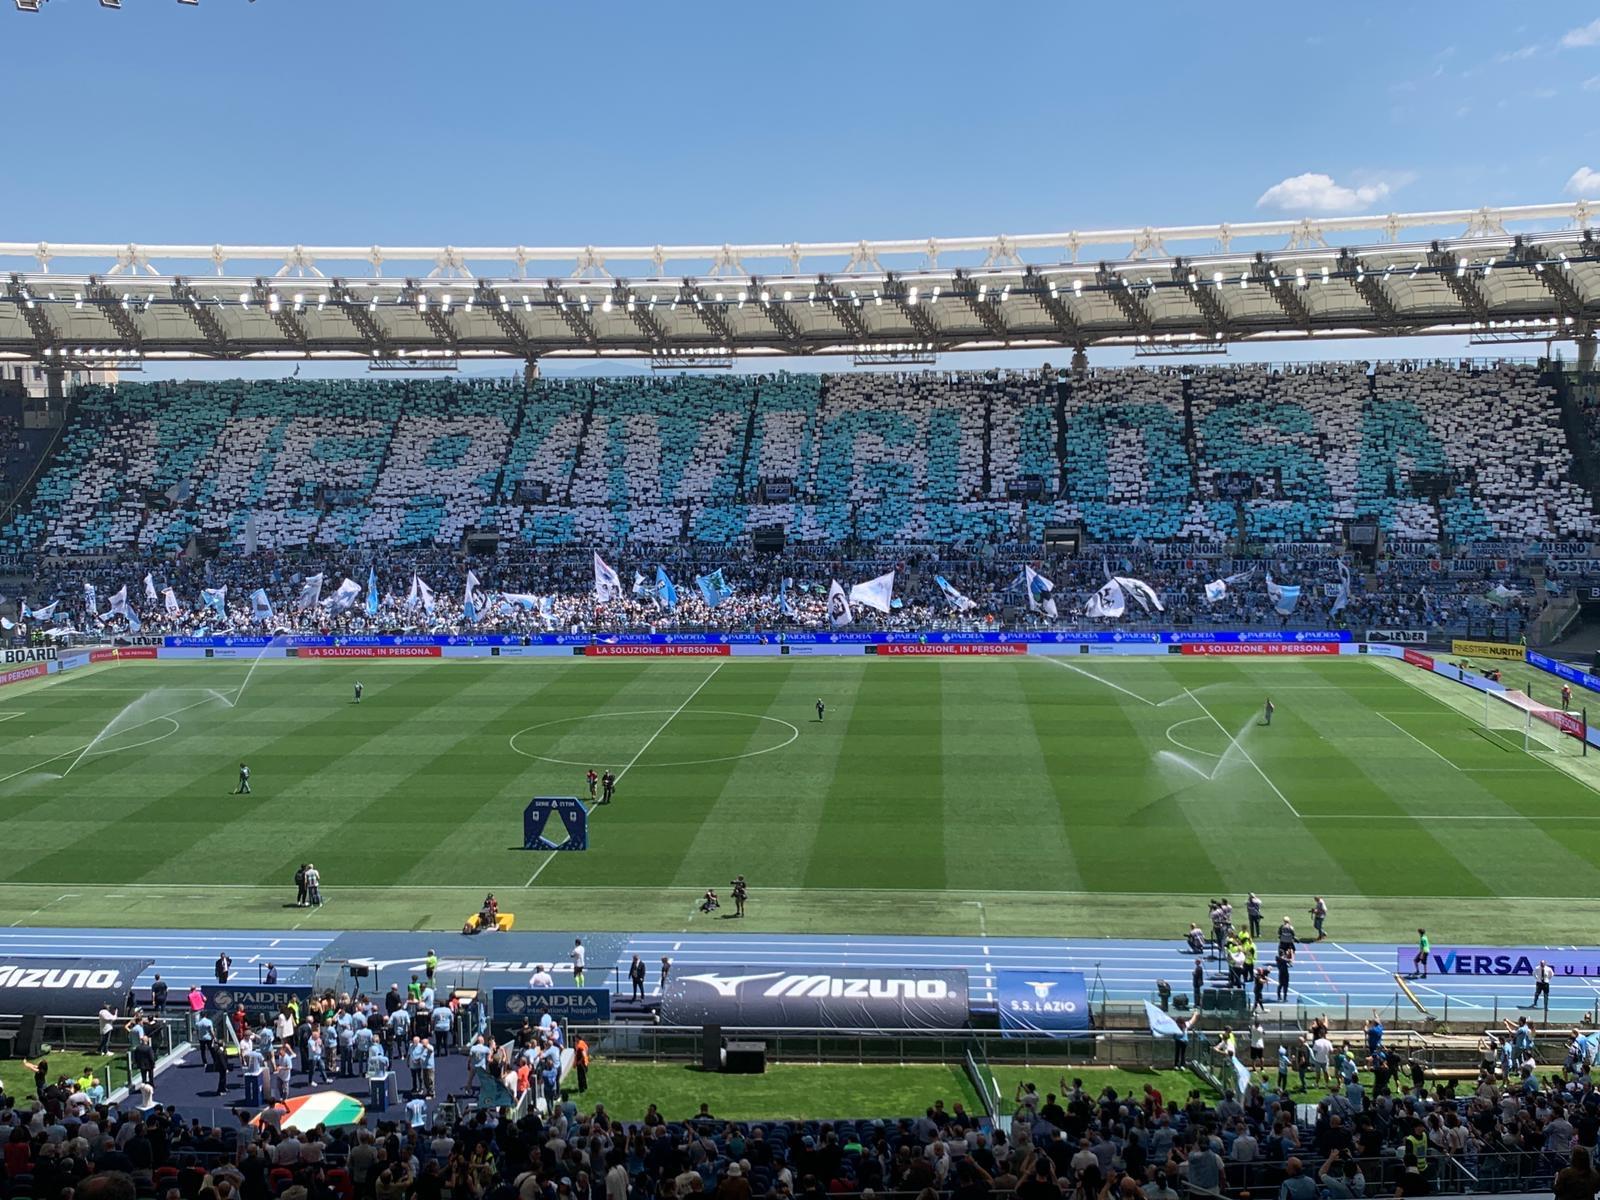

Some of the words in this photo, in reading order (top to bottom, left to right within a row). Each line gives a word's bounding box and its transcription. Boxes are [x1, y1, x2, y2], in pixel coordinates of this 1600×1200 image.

[596, 646, 608, 654] LA
[610, 646, 664, 655] SOLUZIONE,
[665, 646, 675, 654] IN
[681, 646, 722, 654] PERSONA.
[888, 645, 901, 653] LA
[902, 645, 958, 654] SOLUZIONE,
[960, 645, 969, 653] IN
[974, 645, 1019, 653] PERSONA.
[1193, 645, 1206, 653] LA
[1208, 645, 1266, 654] SOLUZIONE,
[1268, 645, 1279, 653] IN
[1284, 645, 1330, 653] PERSONA.
[1454, 642, 1488, 654] FINESTRE
[1489, 646, 1523, 657] NURITH
[5, 648, 58, 663] BOARD
[1433, 950, 1533, 974] VERSA
[233, 992, 289, 1003] PAIDEI
[526, 995, 597, 1006] PAIDEIA
[570, 1007, 598, 1016] hospital
[1036, 1001, 1075, 1012] LAZIO
